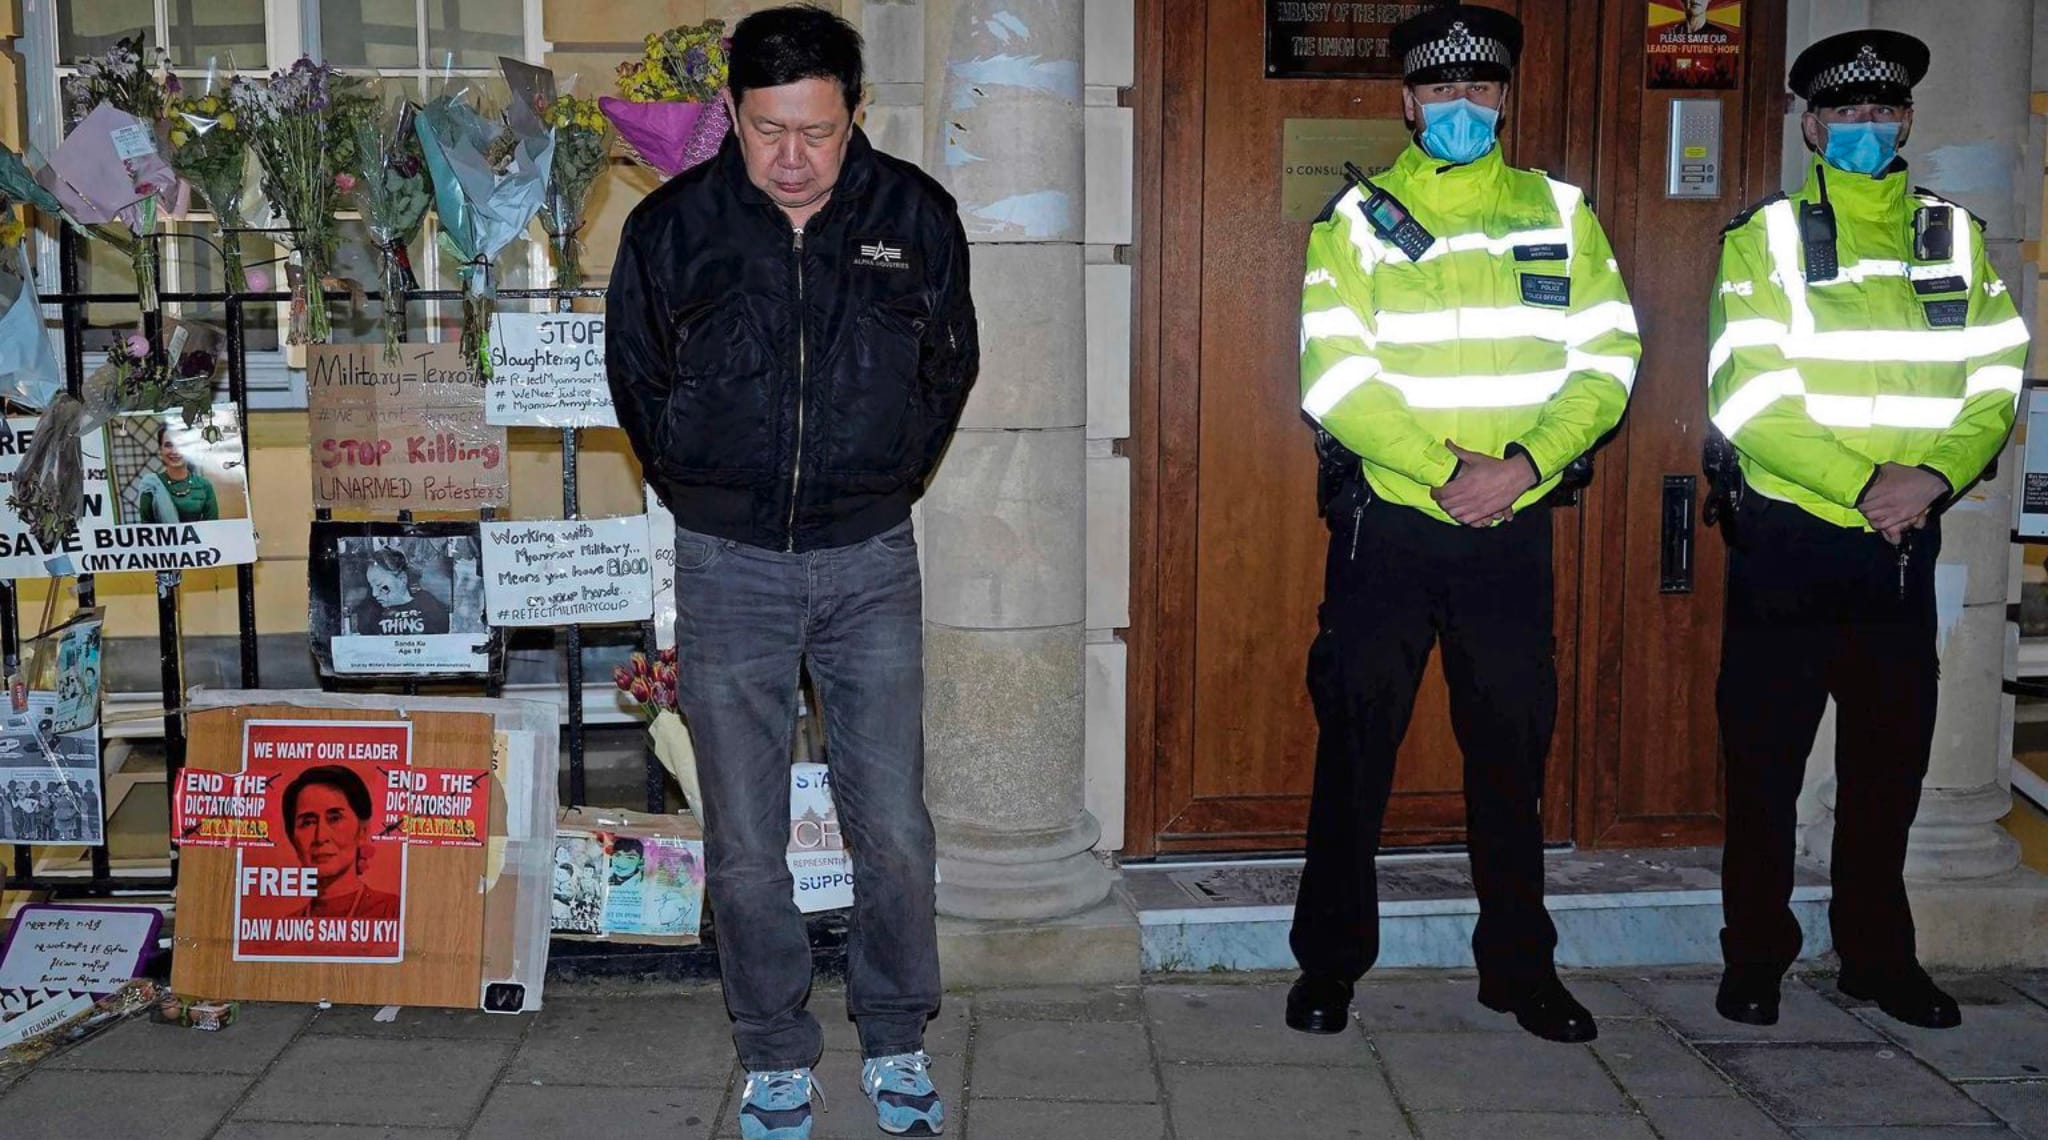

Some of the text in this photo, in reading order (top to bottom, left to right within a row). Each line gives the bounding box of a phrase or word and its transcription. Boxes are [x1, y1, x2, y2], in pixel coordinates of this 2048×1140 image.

[1278, 2, 1331, 22] EMBASSY
[1334, 3, 1349, 23] OF
[1351, 3, 1375, 23] THE
[1292, 36, 1315, 57] THE
[1317, 37, 1354, 57] UNION
[1357, 37, 1374, 57] OF
[1660, 33, 1727, 43] PLEASE SAVE OUR
[1647, 44, 1740, 54] LEADER FUTURE HOPE
[1297, 165, 1363, 176] CONSUL
[540, 320, 604, 345] STOP
[492, 347, 580, 372] Slaughtering
[321, 432, 501, 469] STOP Killing
[320, 476, 505, 501] UNARMED Protesters
[94, 525, 202, 548] BURMA
[490, 524, 594, 549] Working with
[81, 547, 221, 571] (MYANMAR)
[515, 547, 575, 566] Myanmar
[498, 571, 540, 586] Means
[544, 573, 568, 586] you
[572, 565, 604, 578] have
[378, 618, 425, 634] THING
[254, 742, 398, 760] WE WANT OUR LEADER
[186, 774, 267, 794] END THE
[388, 770, 472, 793] END THE
[184, 795, 265, 817] DICTATORSHIP
[386, 791, 472, 816] DICTATORSHIP
[184, 818, 196, 826] IN
[386, 814, 398, 823] IN
[242, 867, 318, 897] FREE
[799, 873, 855, 891] SUPPO
[241, 918, 398, 943] DAW AUNG SAN SU KYI
[28, 1014, 58, 1036] FULHAM
[57, 1010, 68, 1020] FC
